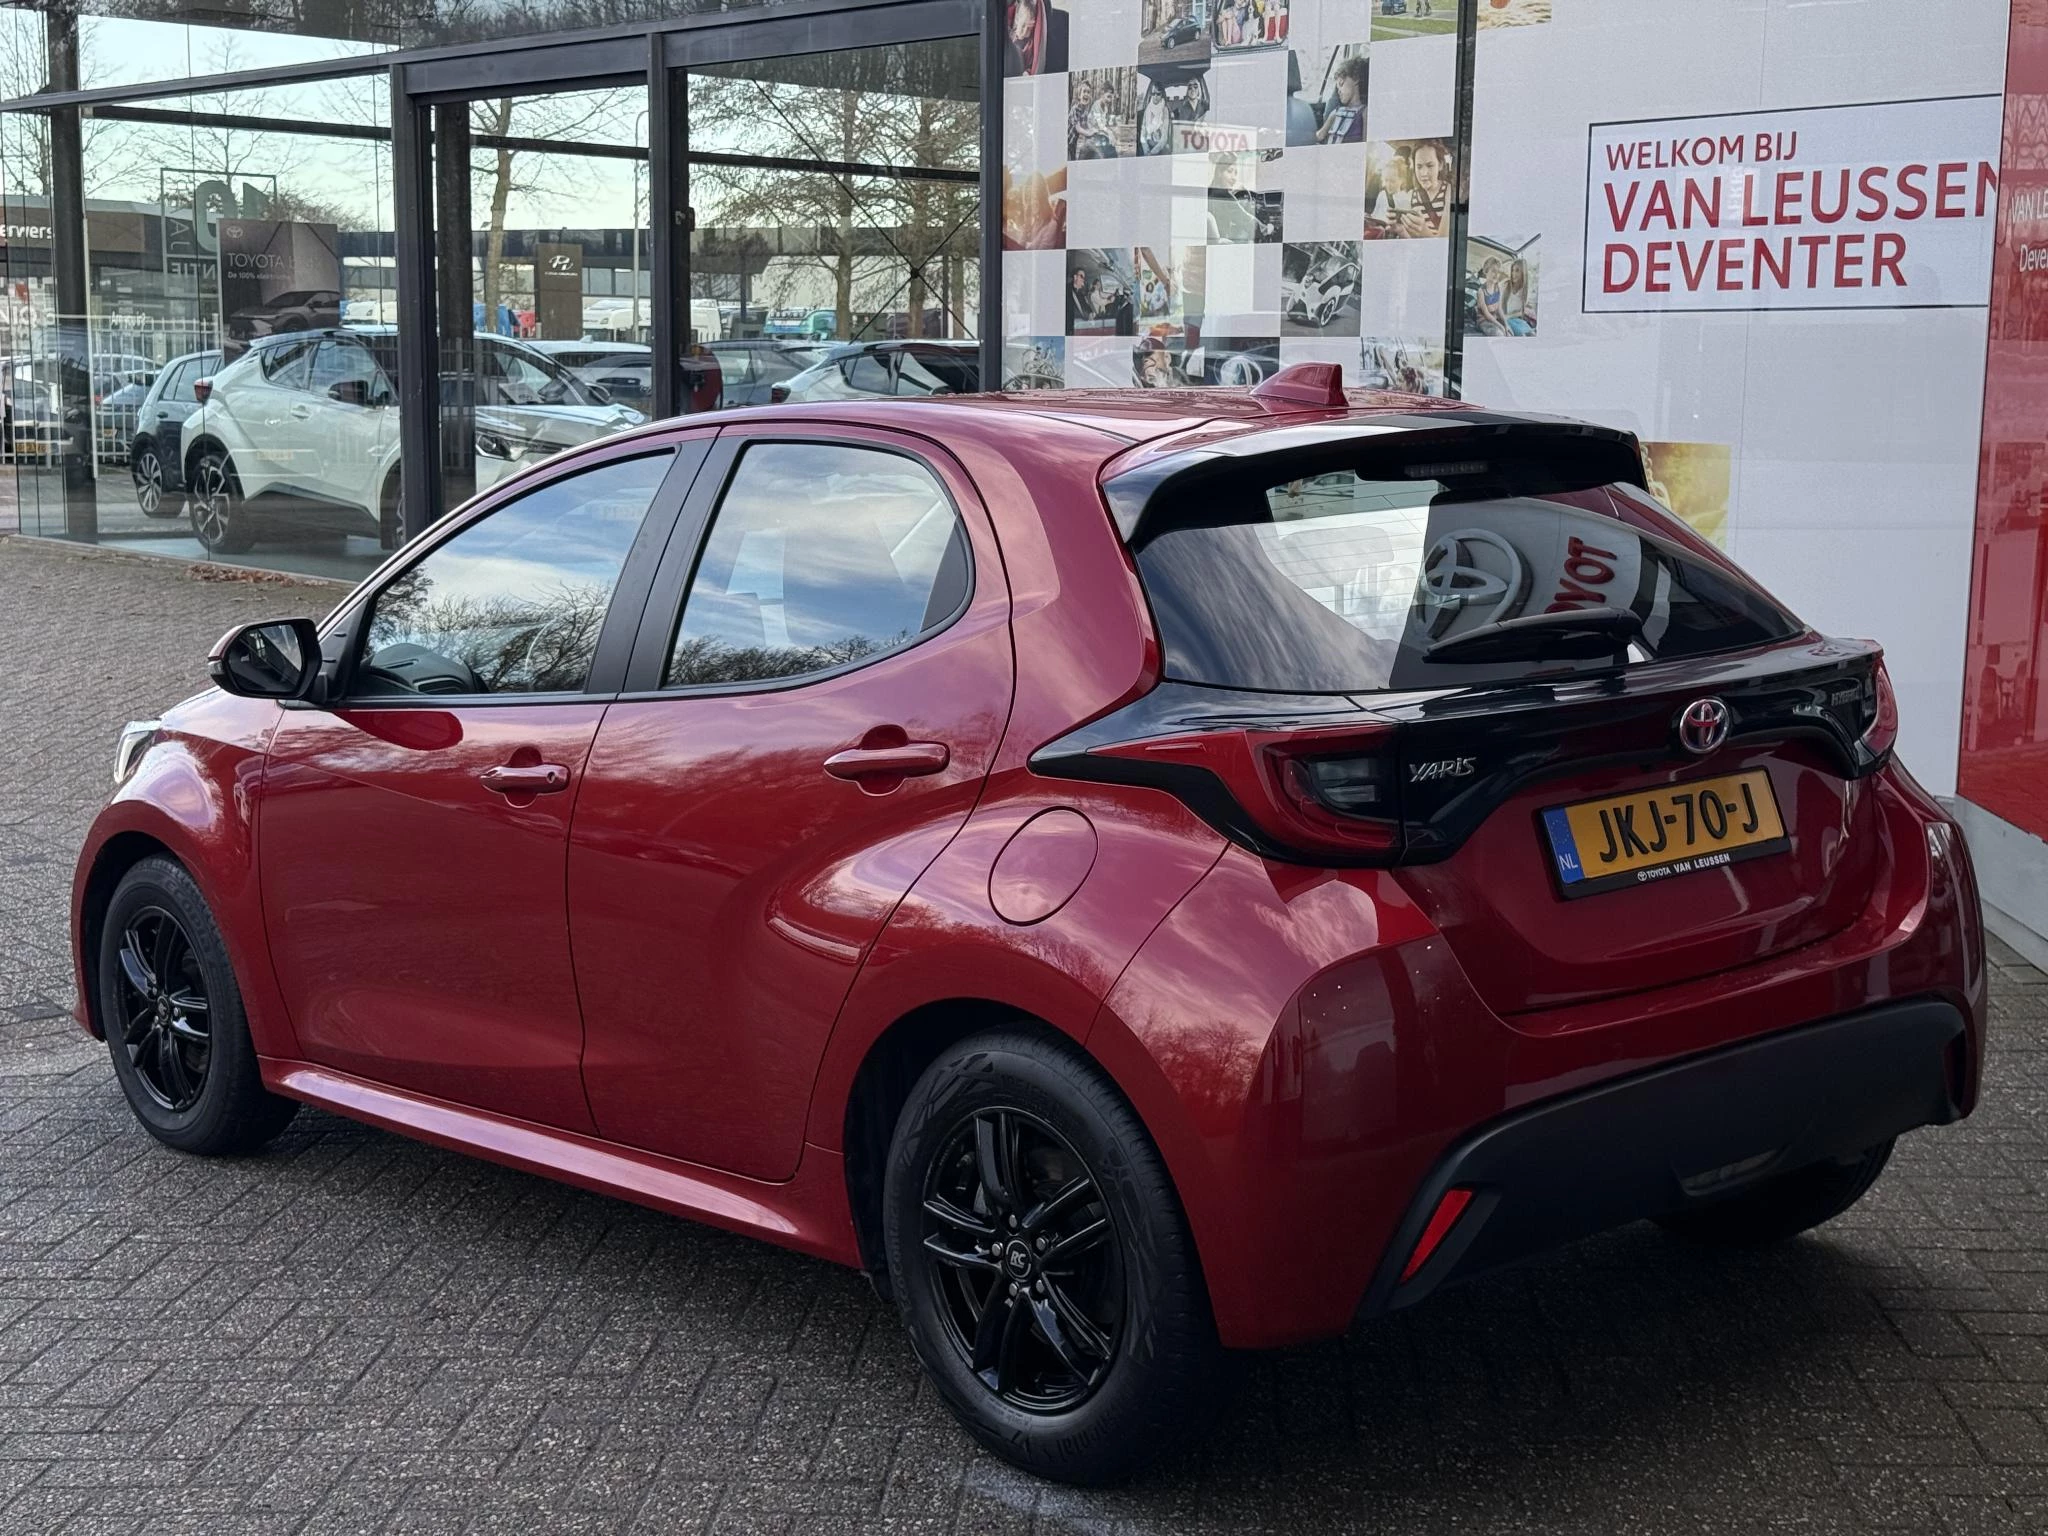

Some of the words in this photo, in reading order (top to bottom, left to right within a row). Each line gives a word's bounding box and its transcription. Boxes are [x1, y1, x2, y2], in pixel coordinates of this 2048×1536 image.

[1181, 130, 1249, 151] TOYOTA
[1606, 134, 1744, 171] WELKOM
[1755, 131, 1797, 162] BIJ
[1604, 176, 1722, 232] VAN
[1742, 161, 1998, 227] LEUSSEN
[2011, 191, 2033, 224] VAN
[227, 253, 285, 269] TOYOTA
[1603, 233, 1908, 293] DEVENTER
[2019, 243, 2048, 272] Deve
[1409, 757, 1477, 782] YARIS
[1599, 783, 1759, 862] JKJ-70-J
[1559, 854, 1579, 871] NL
[1647, 867, 1671, 879] TOYOTA
[1673, 862, 1691, 873] VAN
[1693, 853, 1731, 869] LEUSSEN
[1010, 1250, 1027, 1269] RC
